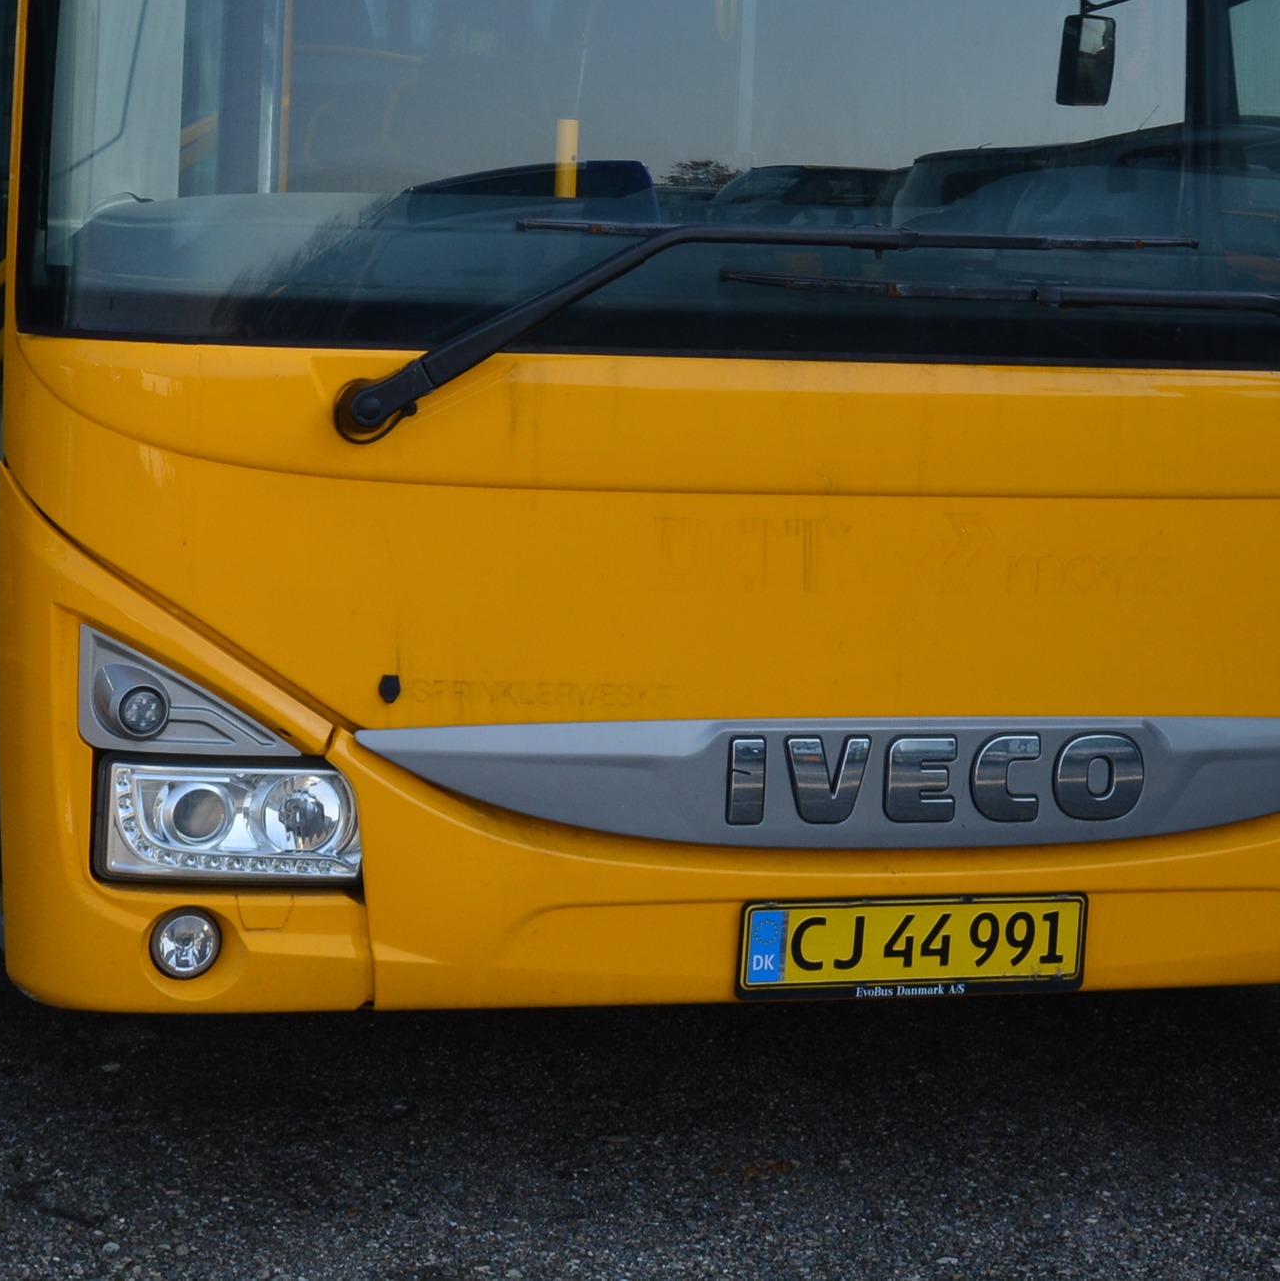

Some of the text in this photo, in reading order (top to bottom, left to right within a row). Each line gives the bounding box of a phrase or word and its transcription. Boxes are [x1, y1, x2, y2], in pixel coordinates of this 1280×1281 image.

[725, 731, 1145, 825] IVECO
[790, 910, 1064, 972] CJ 44 991
[753, 954, 775, 971] DK
[856, 984, 965, 997] EvoBus Danmark A/S
